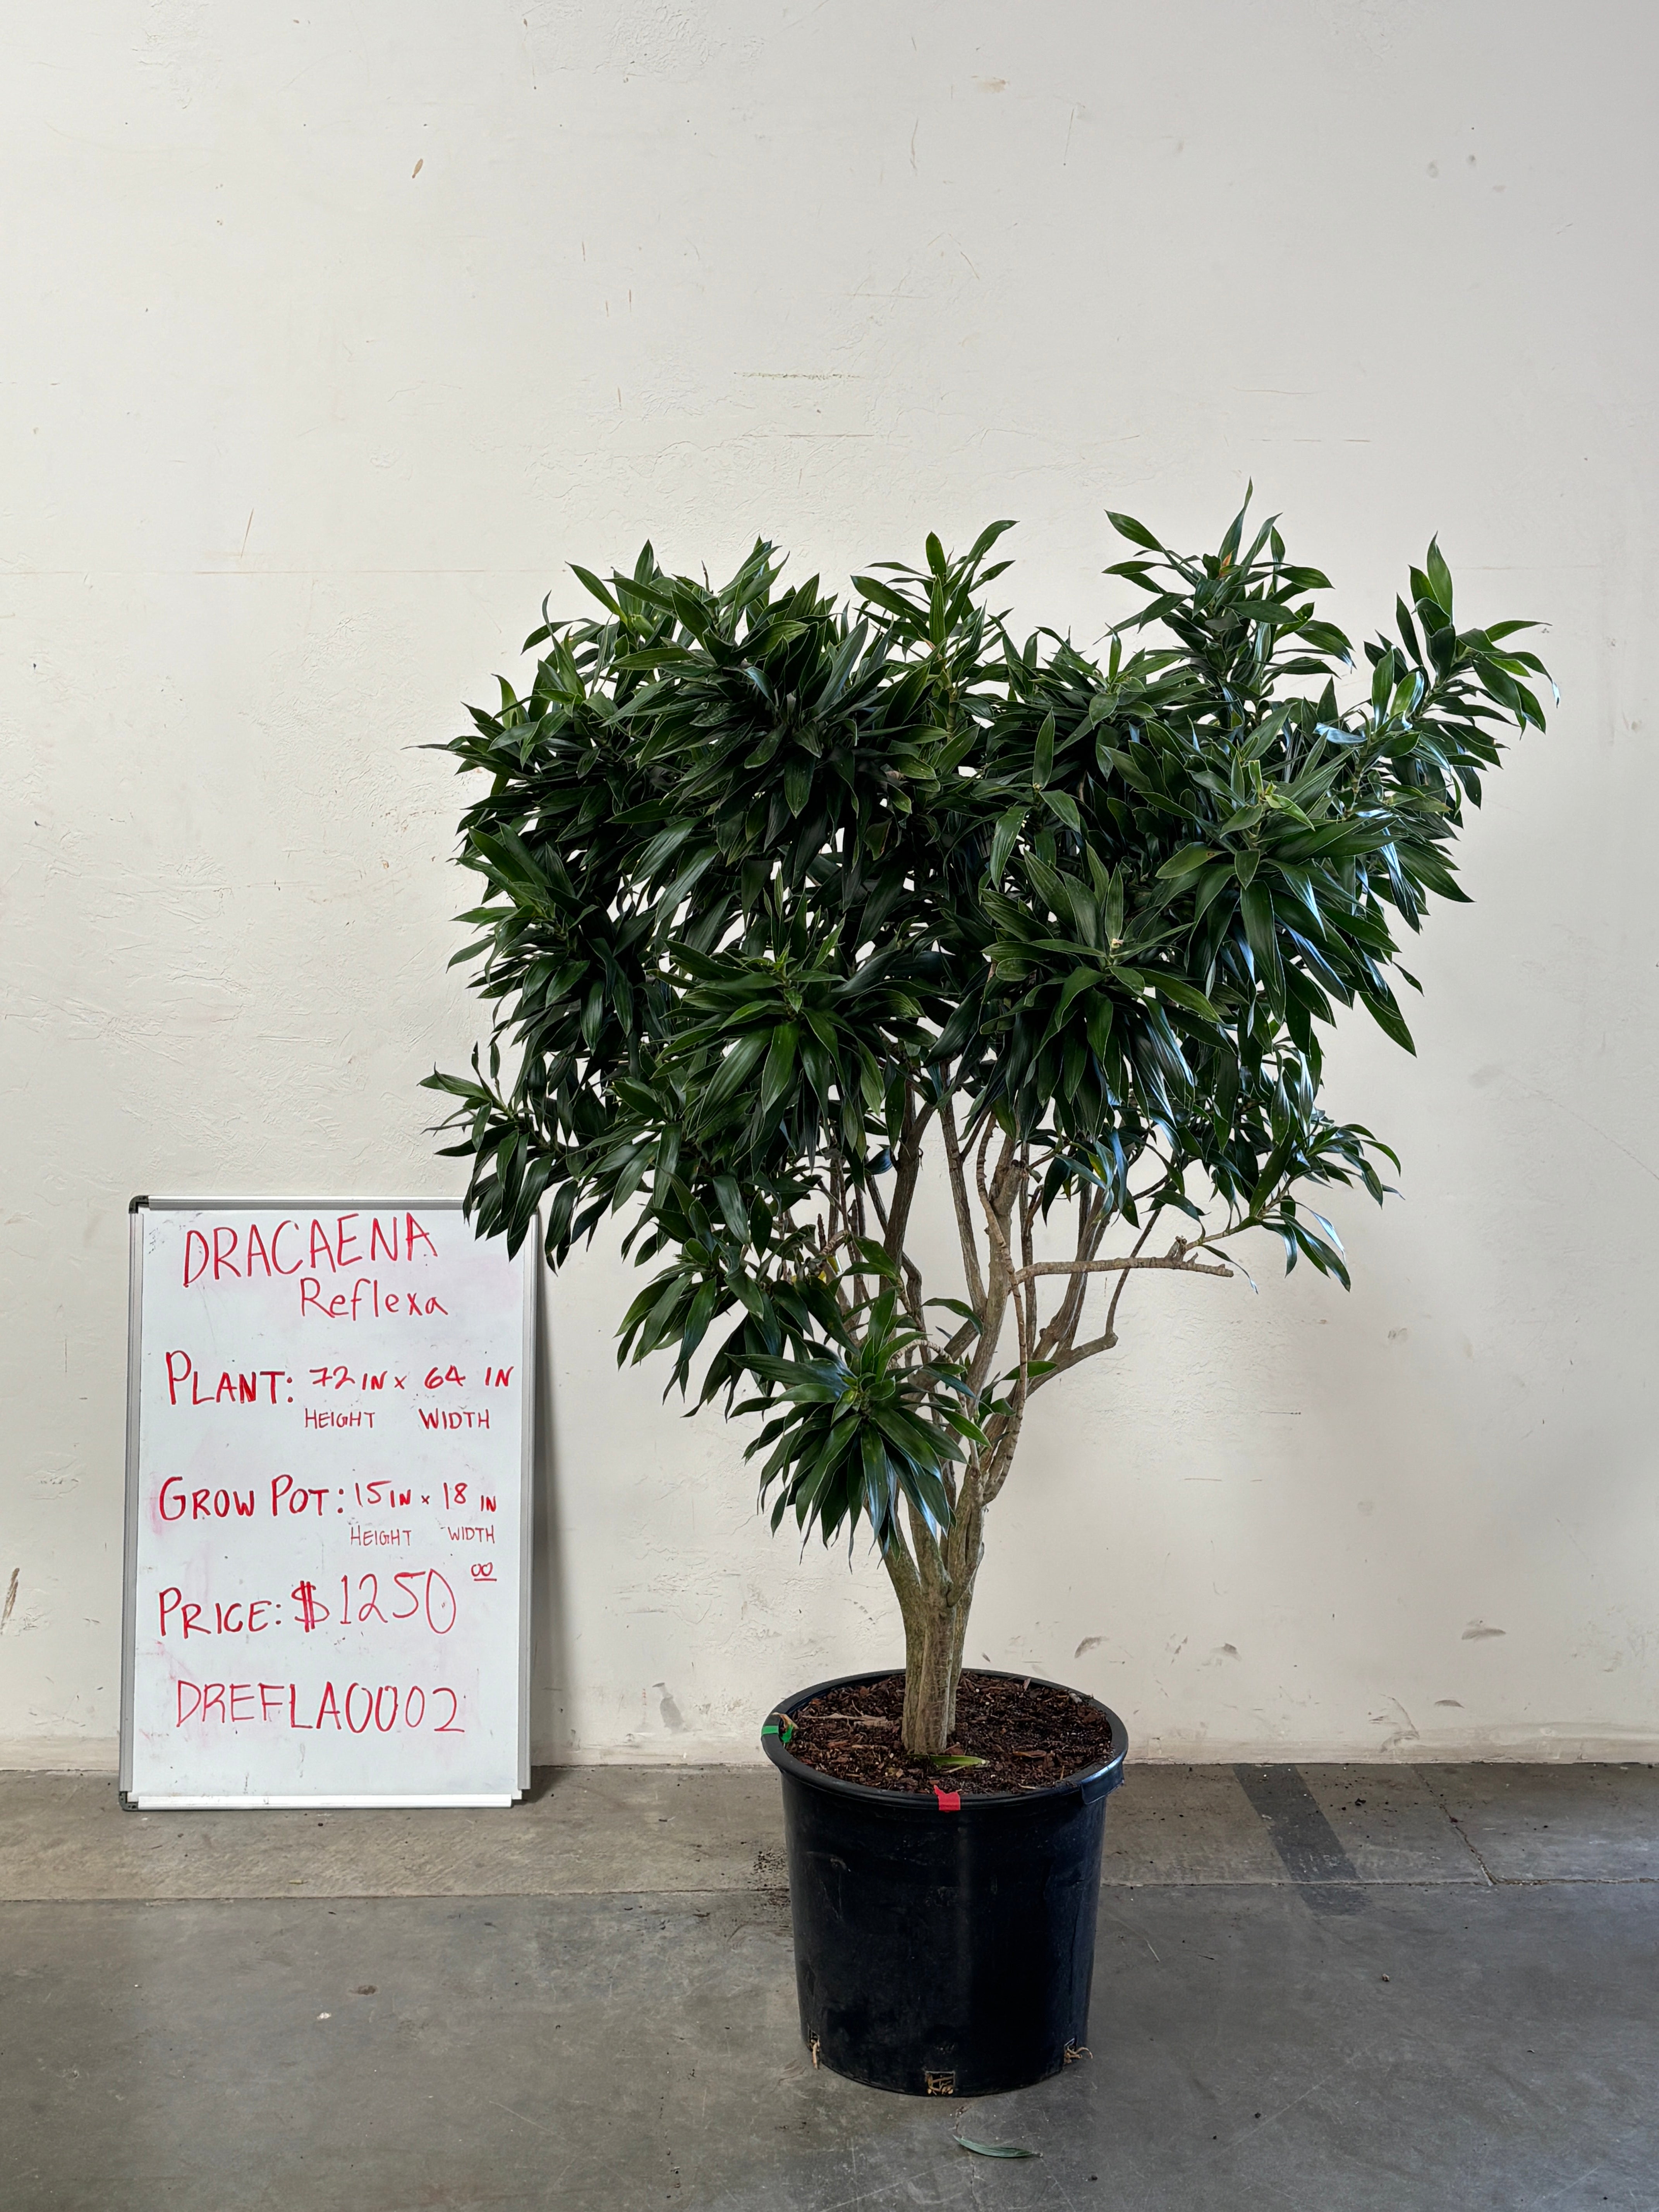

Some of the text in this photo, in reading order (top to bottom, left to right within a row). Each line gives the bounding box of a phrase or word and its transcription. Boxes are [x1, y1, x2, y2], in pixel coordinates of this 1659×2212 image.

[182, 1212, 438, 1288] DRACAENA
[299, 1277, 449, 1321] Reflexa
[165, 1350, 293, 1406] PLANT:
[423, 1365, 466, 1390] 64
[484, 1366, 514, 1388] IN
[304, 1408, 490, 1430] HEIGHT WIDTH
[159, 1476, 255, 1521] GROW
[271, 1474, 344, 1517] POT:
[443, 1482, 468, 1510] 18
[480, 1495, 497, 1513] IN
[350, 1524, 495, 1546] HEIGHT WIDTH
[158, 1587, 282, 1639] PRICE:
[176, 1681, 465, 1733] DREFLA0002
